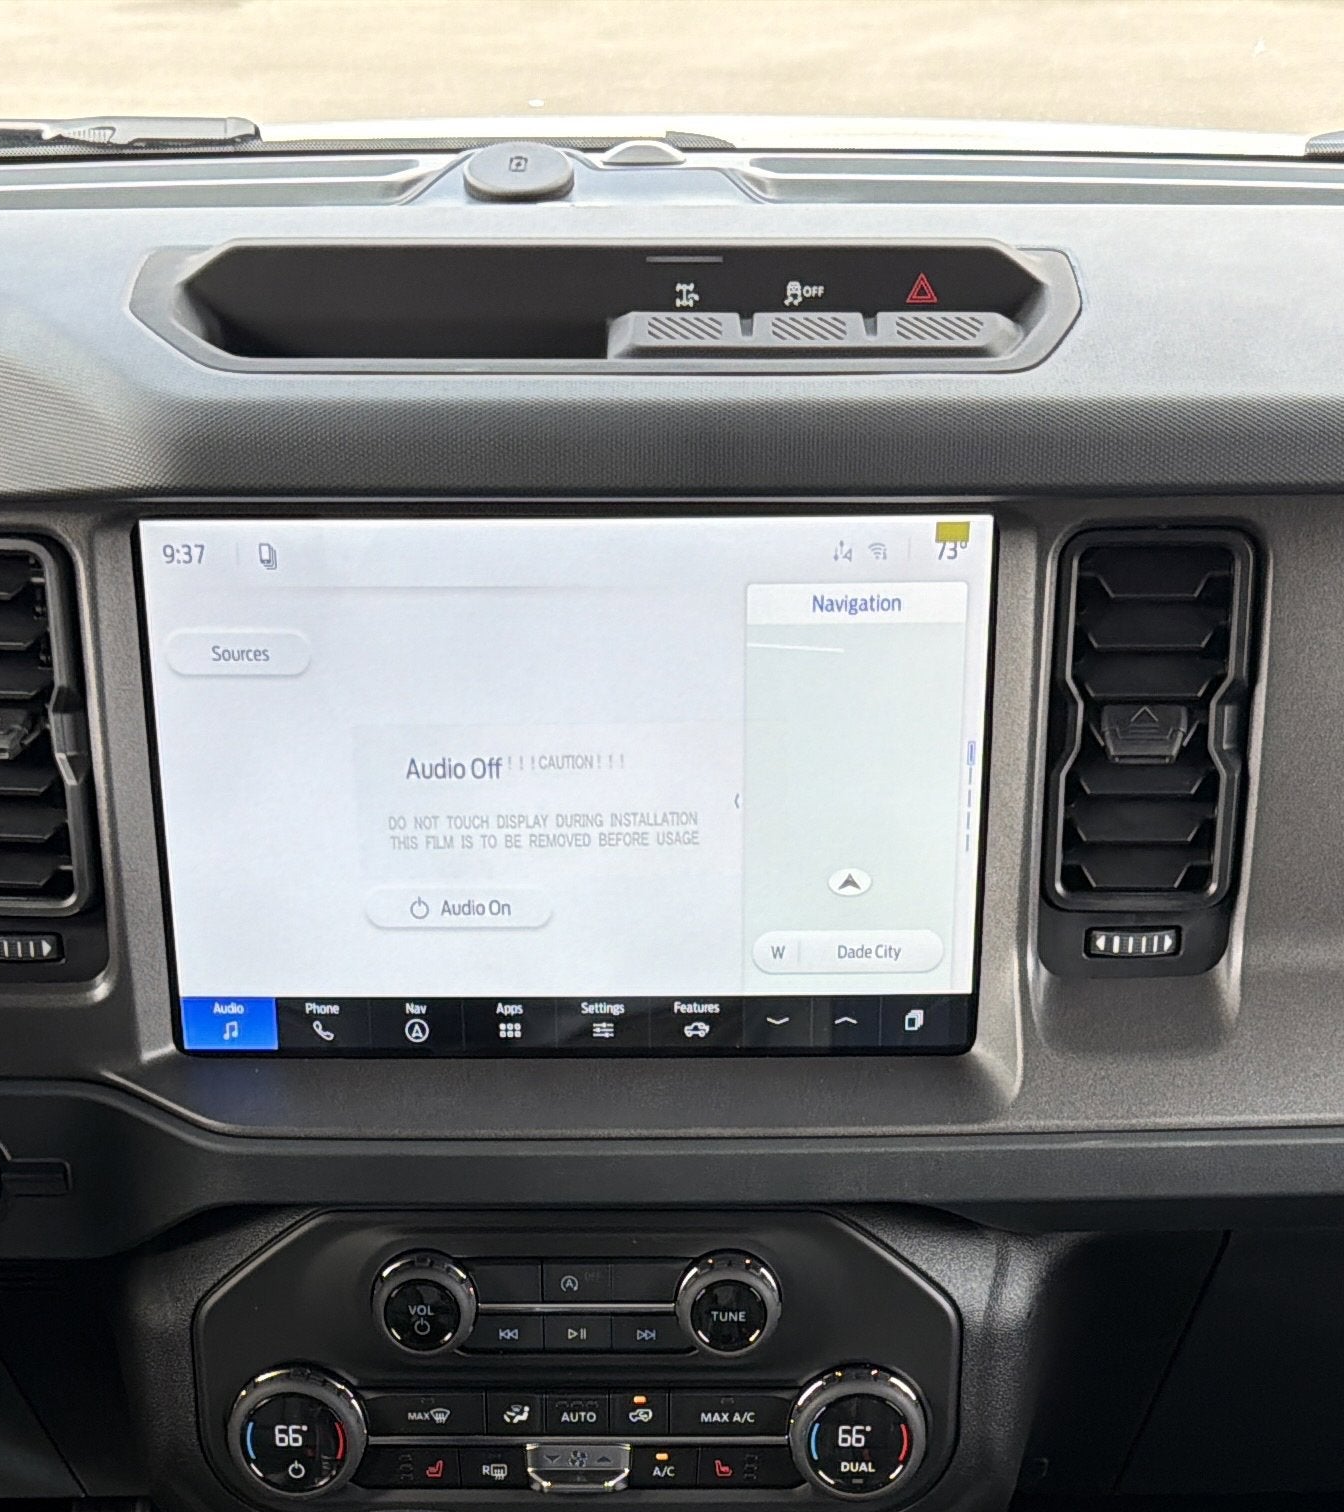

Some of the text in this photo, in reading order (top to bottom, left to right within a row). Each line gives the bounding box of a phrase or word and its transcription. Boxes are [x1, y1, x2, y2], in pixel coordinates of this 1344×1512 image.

[803, 285, 824, 297] OFF
[162, 544, 205, 564] 9:37
[812, 595, 902, 615] Navigation
[211, 645, 270, 662] Sources
[406, 757, 503, 780] Audio Off
[538, 755, 593, 769] CAUTION
[388, 812, 697, 830] DO NOT TOUCH DISPLAY DURING INSTALLATION
[390, 831, 699, 850] THIS FILM IS TO BE REMOVED BEFORE USAGE
[441, 900, 511, 916] Audio On
[771, 945, 785, 959] W
[837, 944, 902, 962] Dade City
[213, 1002, 244, 1015] Audio
[305, 1002, 340, 1015] Phone
[406, 1002, 427, 1015] Nav
[496, 1002, 523, 1017] Apps
[581, 1001, 625, 1017] Settings
[674, 1001, 720, 1014] Features
[408, 1305, 434, 1316] VOL
[711, 1311, 746, 1322] TUNE
[408, 1412, 429, 1421] MAX
[561, 1412, 597, 1423] AUTO
[701, 1411, 755, 1424] MAX A/C
[483, 1465, 490, 1476] R
[652, 1465, 675, 1478] A/C
[840, 1461, 875, 1473] DUAL
